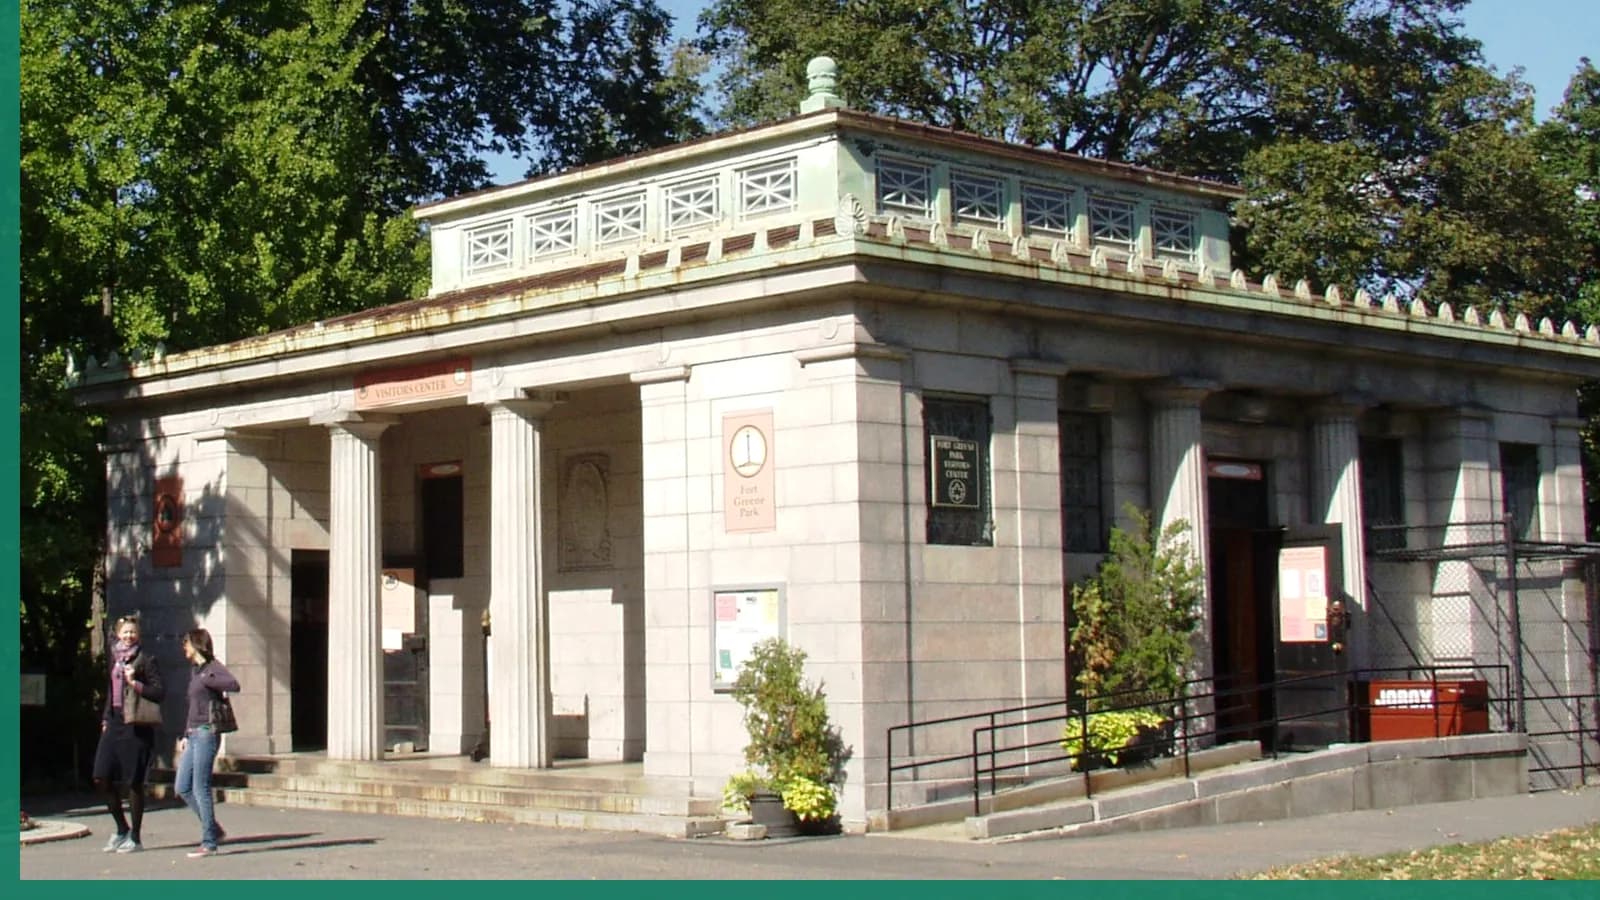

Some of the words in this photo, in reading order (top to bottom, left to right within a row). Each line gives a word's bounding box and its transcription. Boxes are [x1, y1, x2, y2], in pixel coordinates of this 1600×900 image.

[375, 384, 413, 399] VISITORS
[414, 379, 447, 393] CENTER
[945, 470, 969, 479] CENTER
[740, 484, 758, 495] Fort
[733, 497, 765, 507] Greene
[740, 507, 760, 518] Park
[1375, 689, 1434, 709] JOBOX
